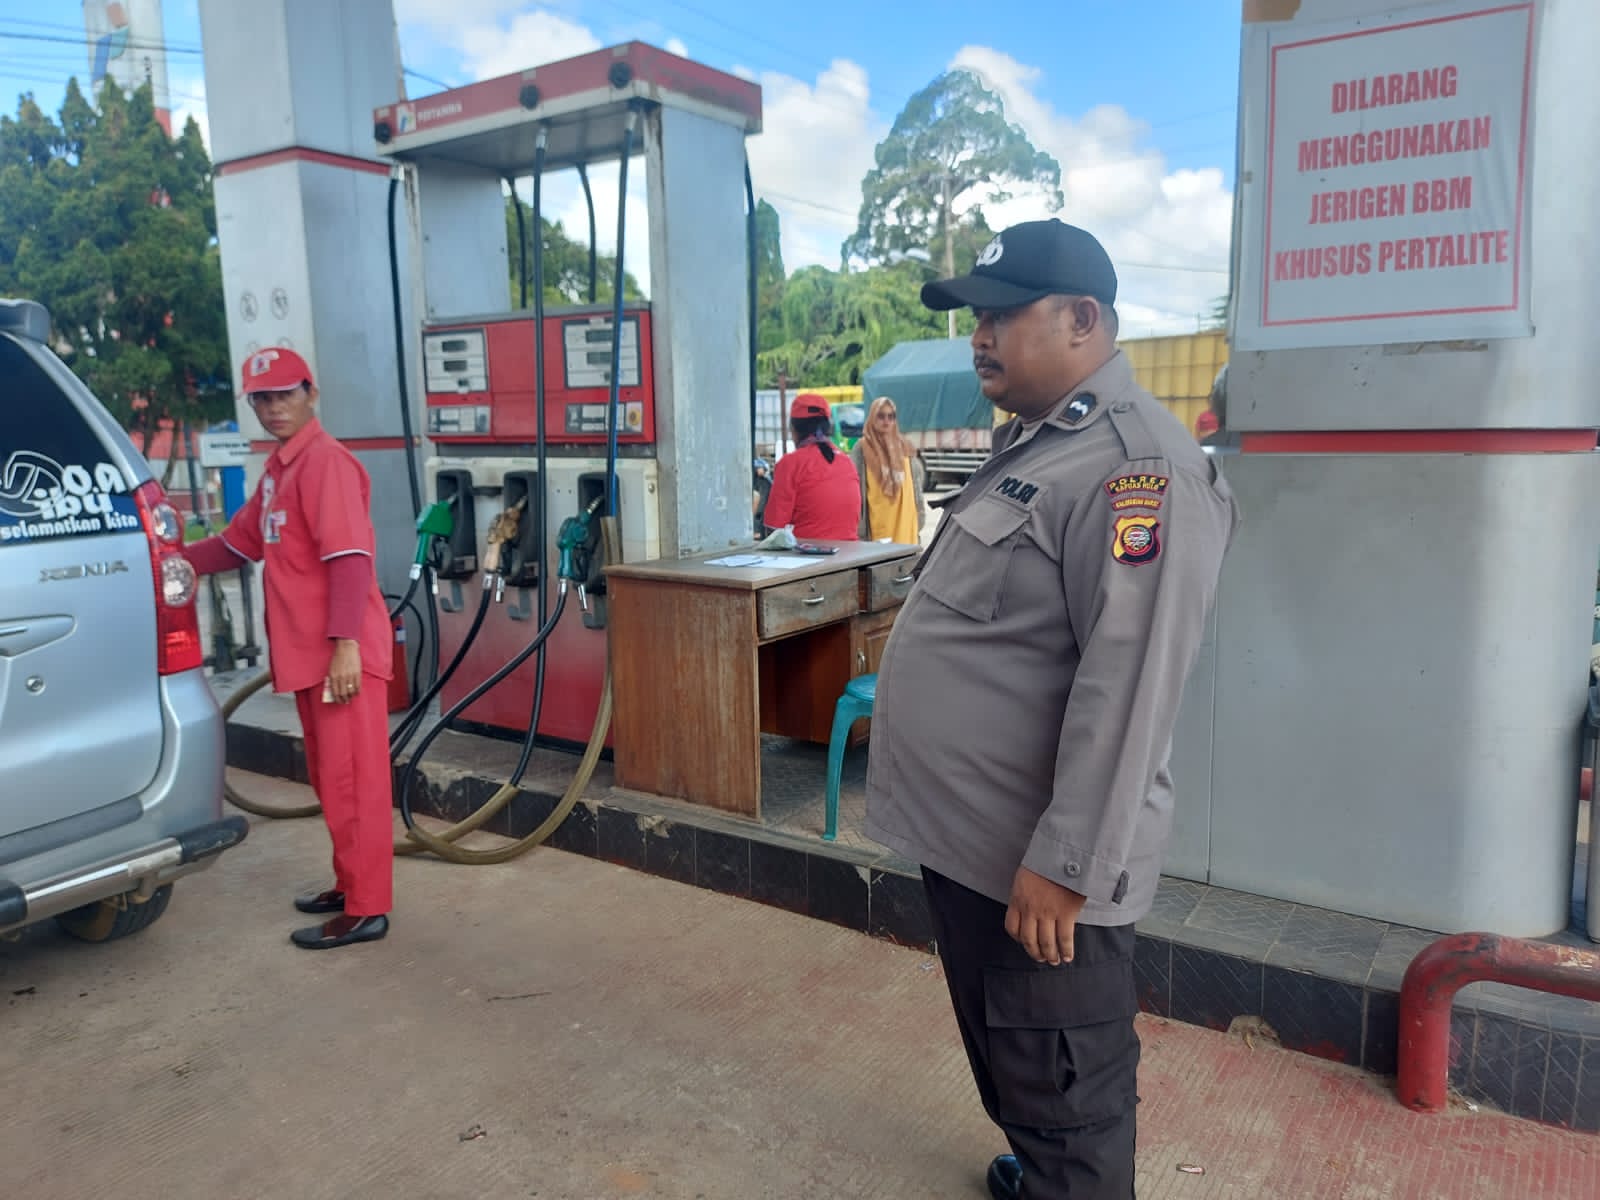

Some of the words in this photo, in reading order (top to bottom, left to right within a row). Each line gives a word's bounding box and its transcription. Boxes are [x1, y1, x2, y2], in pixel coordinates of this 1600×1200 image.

[1331, 65, 1458, 114] DILARANG
[1298, 115, 1491, 173] MENGGUNAKAN
[1309, 183, 1406, 225] JERIGEN
[1412, 176, 1472, 214] BBM
[1273, 242, 1372, 281] KHUSUS
[1378, 230, 1509, 273] PERTALITE
[994, 475, 1040, 505] POLRI
[0, 515, 102, 541] selamatkan
[103, 510, 139, 531] kita
